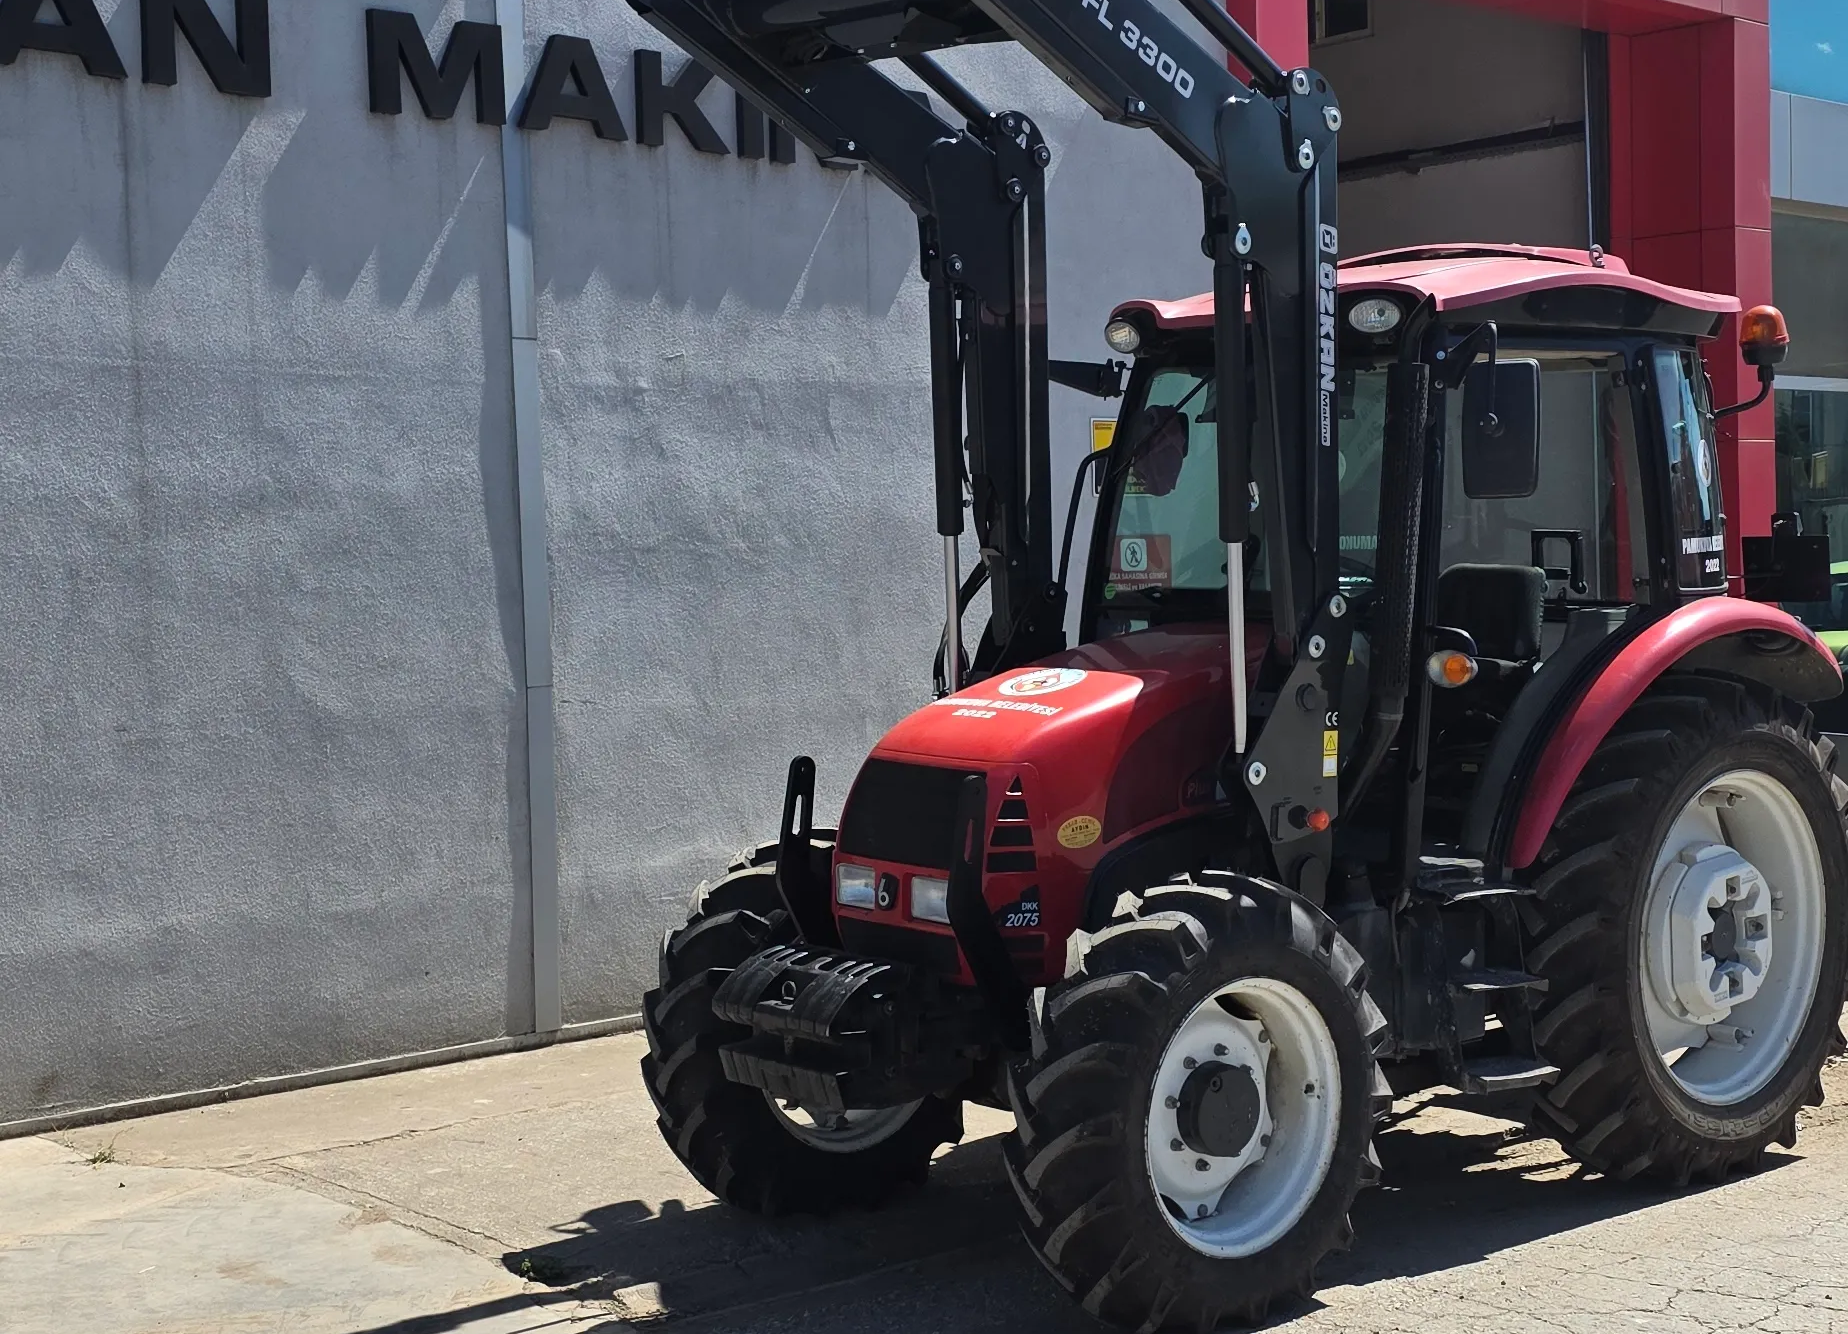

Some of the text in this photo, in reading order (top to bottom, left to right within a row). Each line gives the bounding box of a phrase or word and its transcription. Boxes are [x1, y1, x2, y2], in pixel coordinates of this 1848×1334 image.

[1119, 19, 1195, 99] 3300
[366, 8, 858, 170] MAKI
[1319, 262, 1336, 392] ÖZKAN
[1325, 711, 1339, 727] CE
[1004, 912, 1040, 927] 2075
[1021, 901, 1039, 911] DKK
